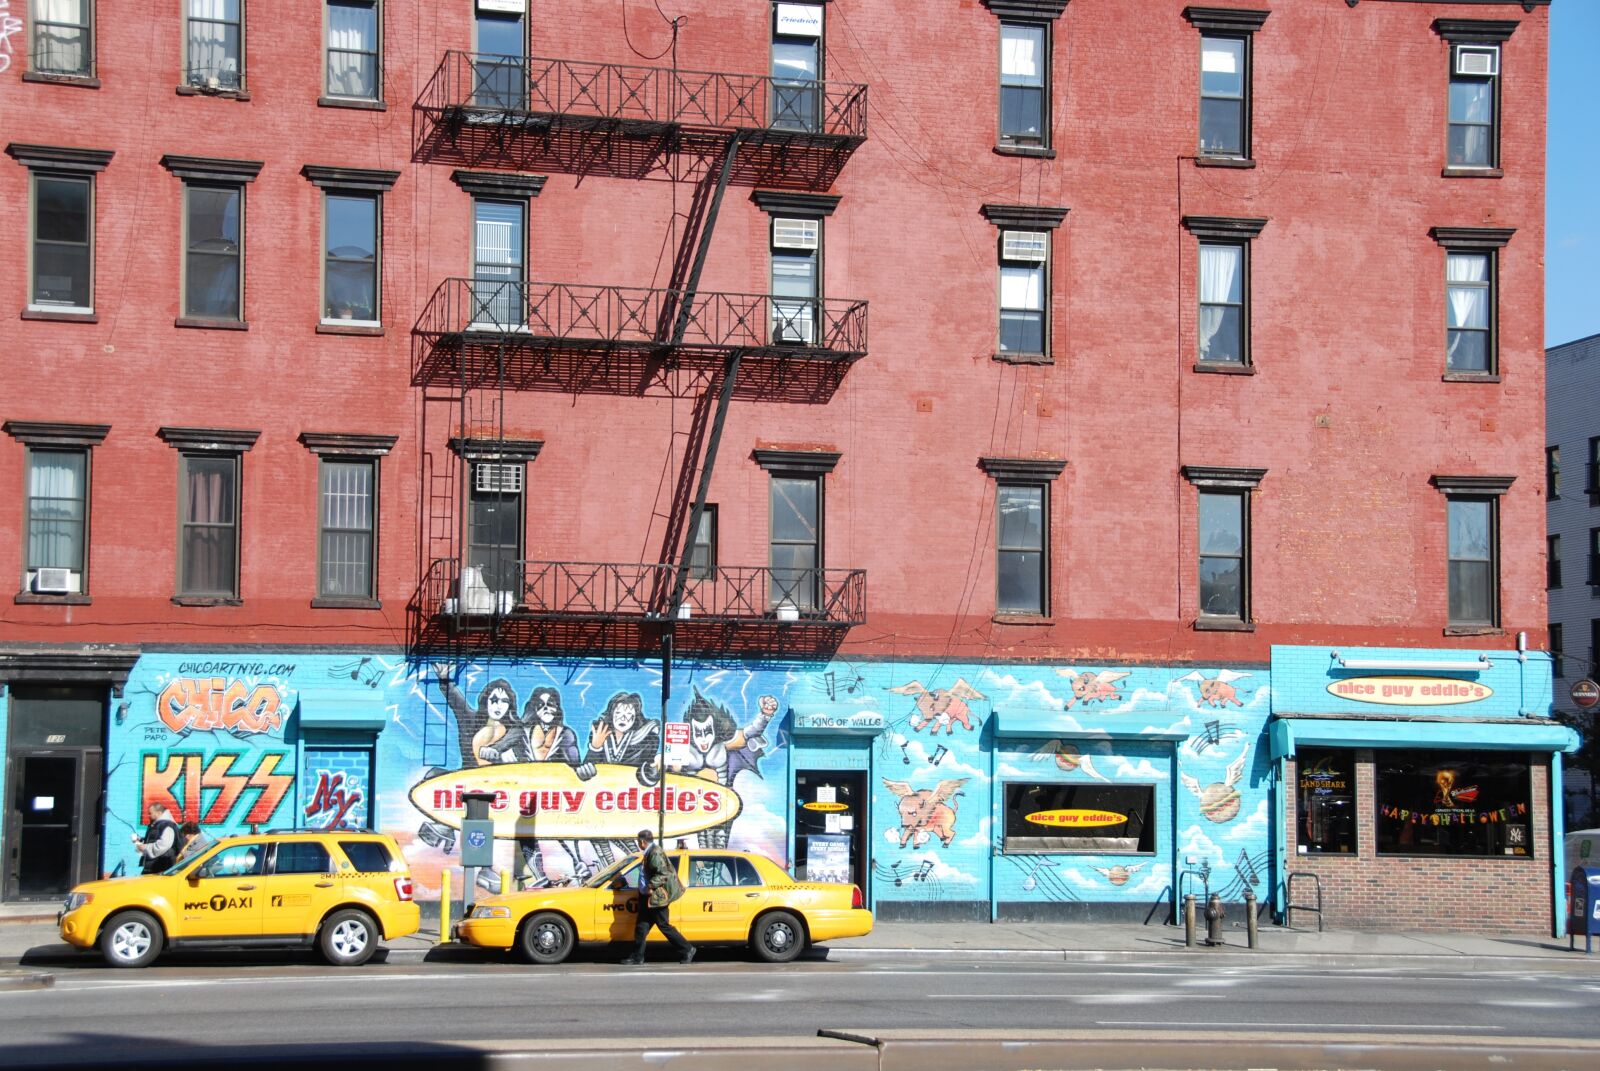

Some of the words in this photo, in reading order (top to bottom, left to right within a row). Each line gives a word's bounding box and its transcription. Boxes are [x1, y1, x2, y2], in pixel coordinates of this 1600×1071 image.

[781, 16, 818, 25] Friedrich
[179, 662, 296, 677] CHICOARTNYC.COM
[1337, 682, 1375, 695] nice
[1382, 684, 1414, 697] guy
[1421, 684, 1484, 697] eddie's
[812, 716, 834, 727] KING
[836, 718, 849, 727] OF
[140, 753, 295, 826] KISS
[434, 785, 507, 809] nie
[519, 791, 585, 816] guy
[595, 787, 720, 812] eddie's
[1059, 815, 1080, 823] guy
[1082, 814, 1123, 822] eddie's
[1381, 803, 1430, 825] HAPPY
[184, 902, 208, 910] NYC
[210, 894, 253, 911] TAXI
[603, 903, 625, 911] NYC
